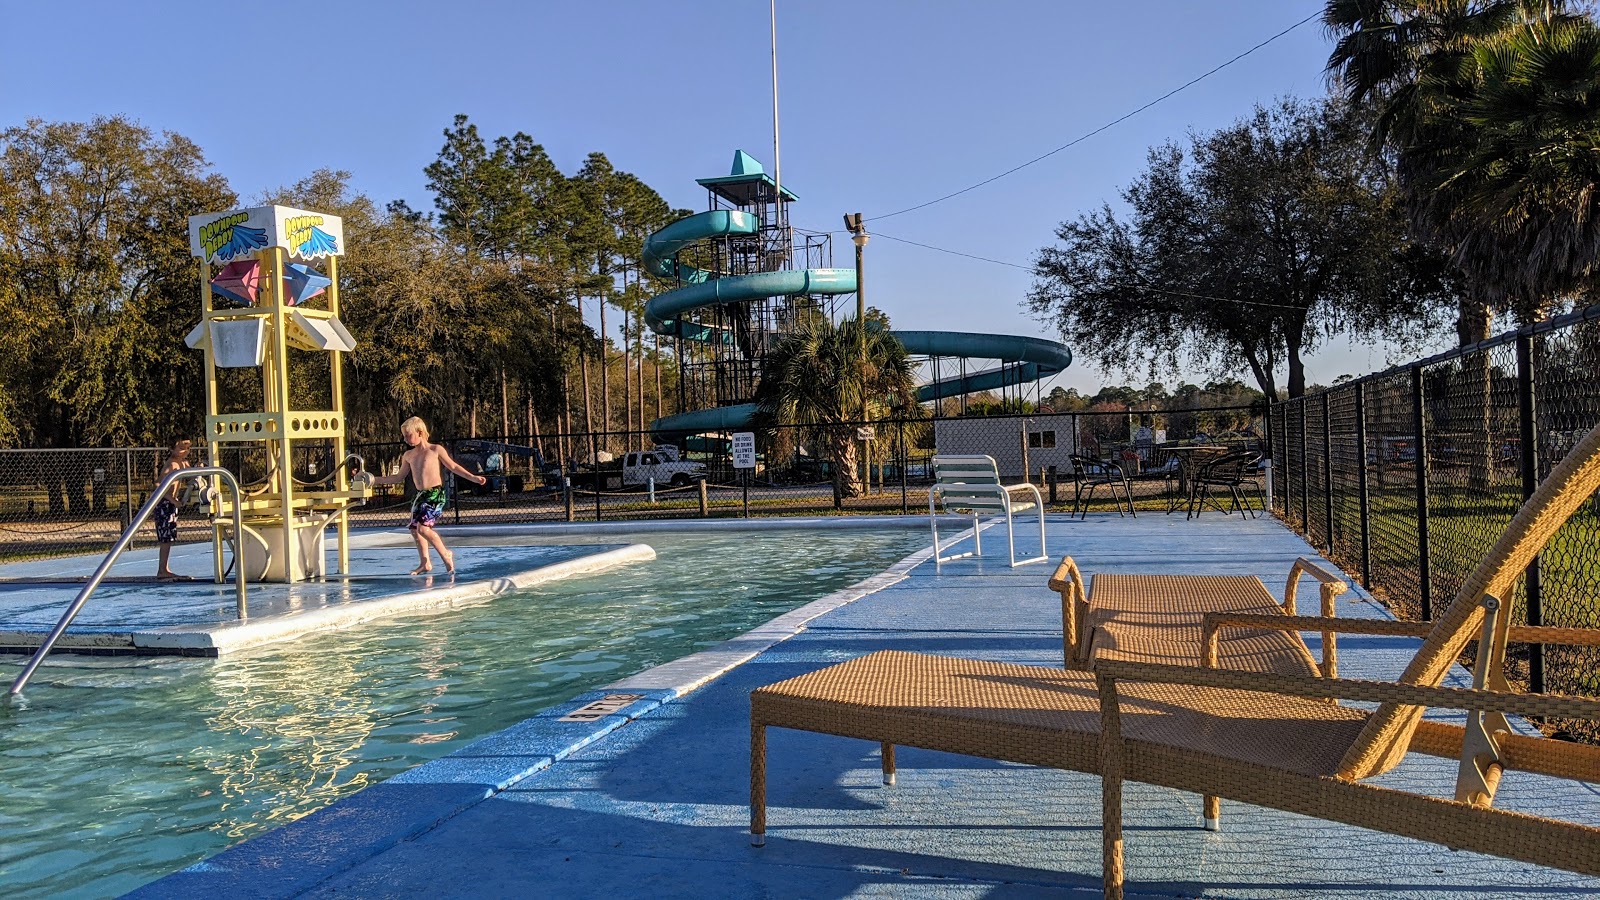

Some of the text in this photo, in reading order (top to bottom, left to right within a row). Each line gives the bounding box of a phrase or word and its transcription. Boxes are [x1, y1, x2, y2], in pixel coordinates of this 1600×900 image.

[199, 212, 249, 249] DOWNPOUR
[285, 215, 324, 240] DOWNPOUR
[290, 227, 313, 255] DERBY
[205, 227, 234, 263] DERBY
